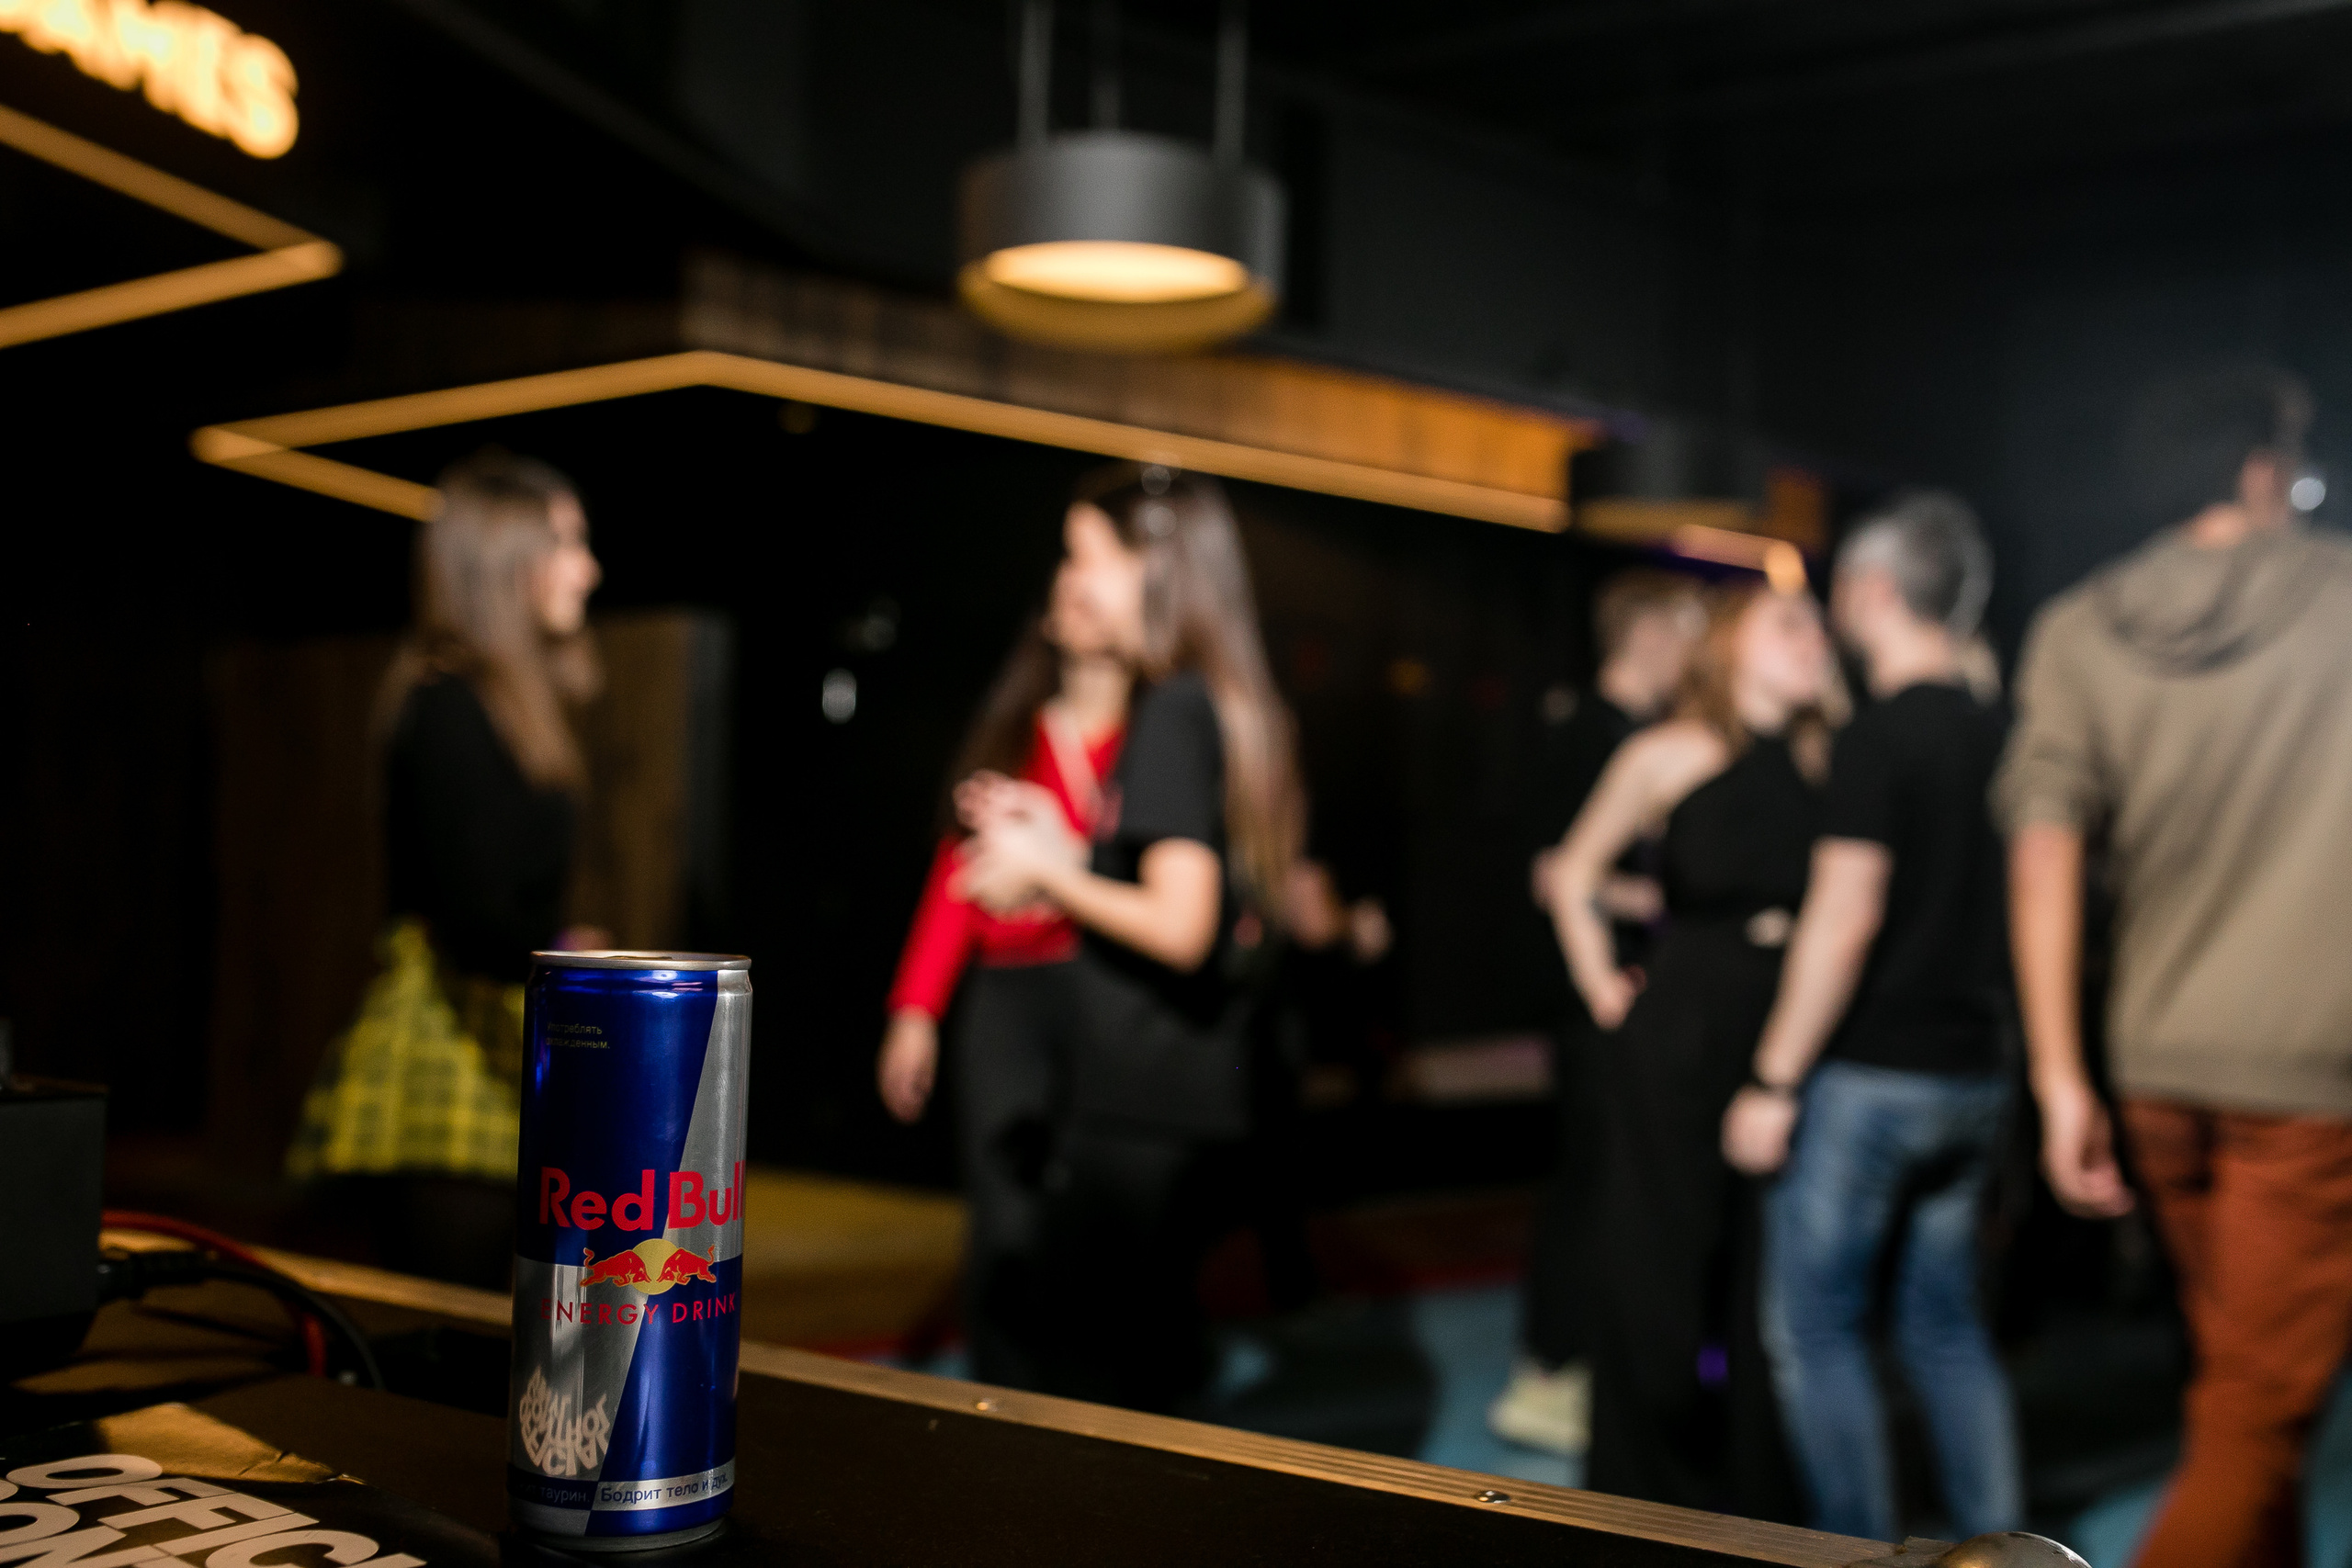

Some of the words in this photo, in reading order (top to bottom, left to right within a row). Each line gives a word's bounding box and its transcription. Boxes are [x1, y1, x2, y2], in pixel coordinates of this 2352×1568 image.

[537, 1165, 656, 1232] Red
[540, 1298, 660, 1325] ENERGY
[671, 1292, 737, 1324] DRINK
[6, 1453, 428, 1568] OFFIC
[538, 1486, 591, 1505] таурин.
[600, 1487, 662, 1505] Бодрит
[666, 1482, 699, 1498] тело
[702, 1479, 709, 1492] и
